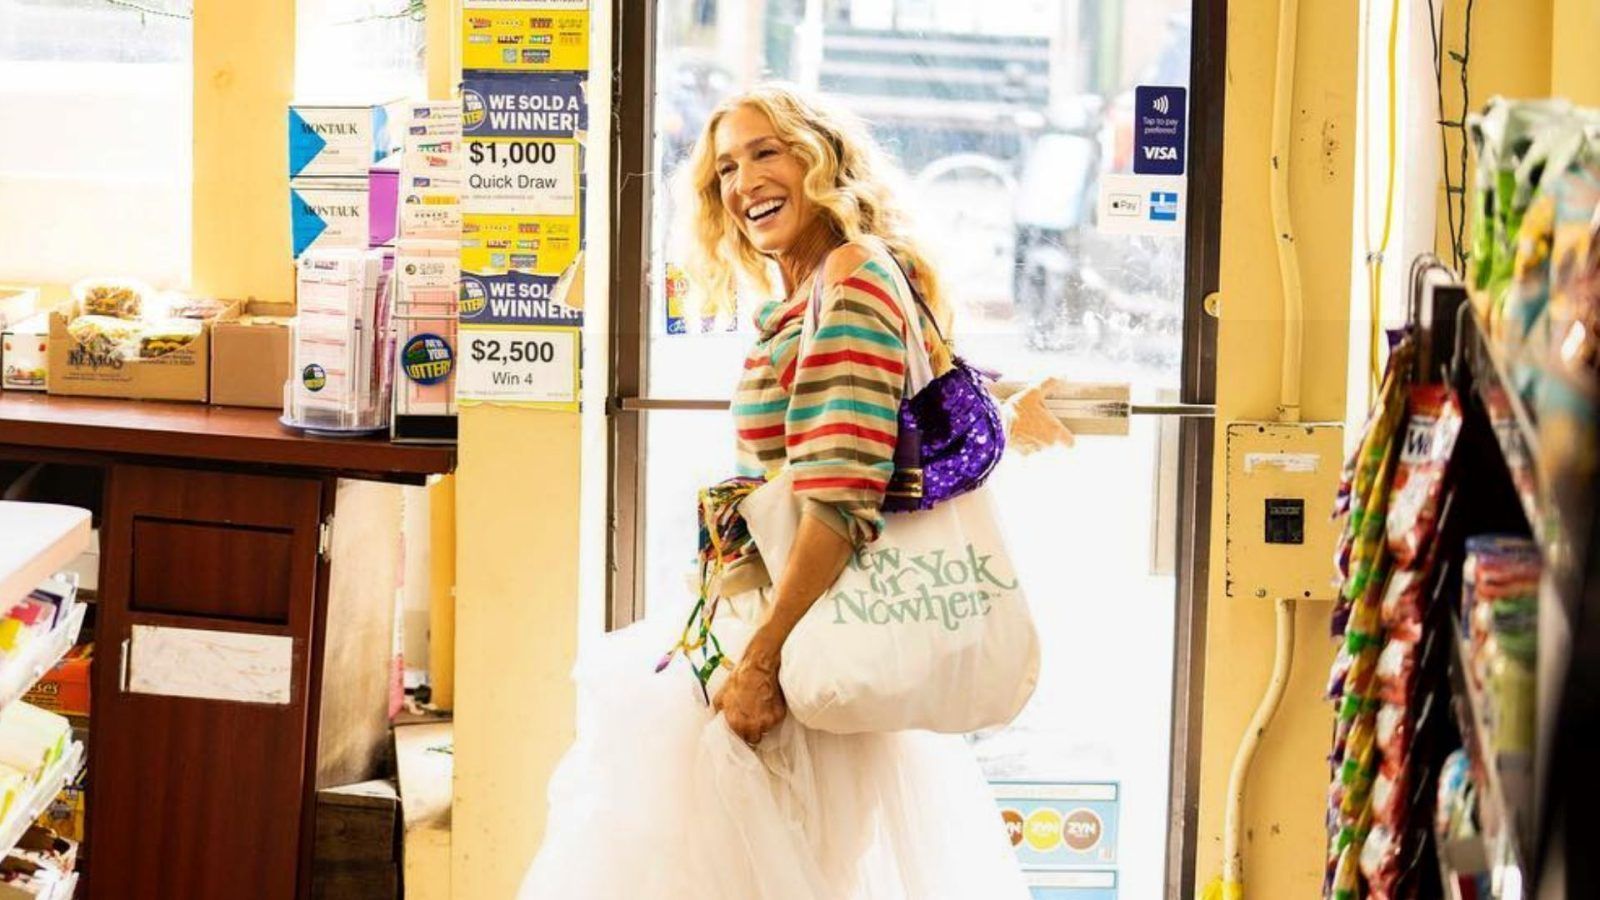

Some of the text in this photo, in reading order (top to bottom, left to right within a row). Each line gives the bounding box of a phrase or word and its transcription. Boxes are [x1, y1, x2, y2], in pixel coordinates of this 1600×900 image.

[489, 95, 579, 110] WE SOLD A
[489, 111, 579, 130] WINNER!
[1143, 117, 1156, 125] Tap
[1165, 119, 1178, 128] pay
[469, 141, 556, 167] $1,000
[1142, 146, 1178, 160] VISA
[469, 174, 512, 189] Quick
[518, 175, 557, 188] Draw
[1120, 200, 1137, 211] Pay
[490, 282, 553, 298] WE SOL
[471, 339, 554, 365] $2,500
[492, 371, 533, 385] Win 4
[832, 584, 993, 631] Nowhere
[1067, 821, 1096, 838] ZYN
